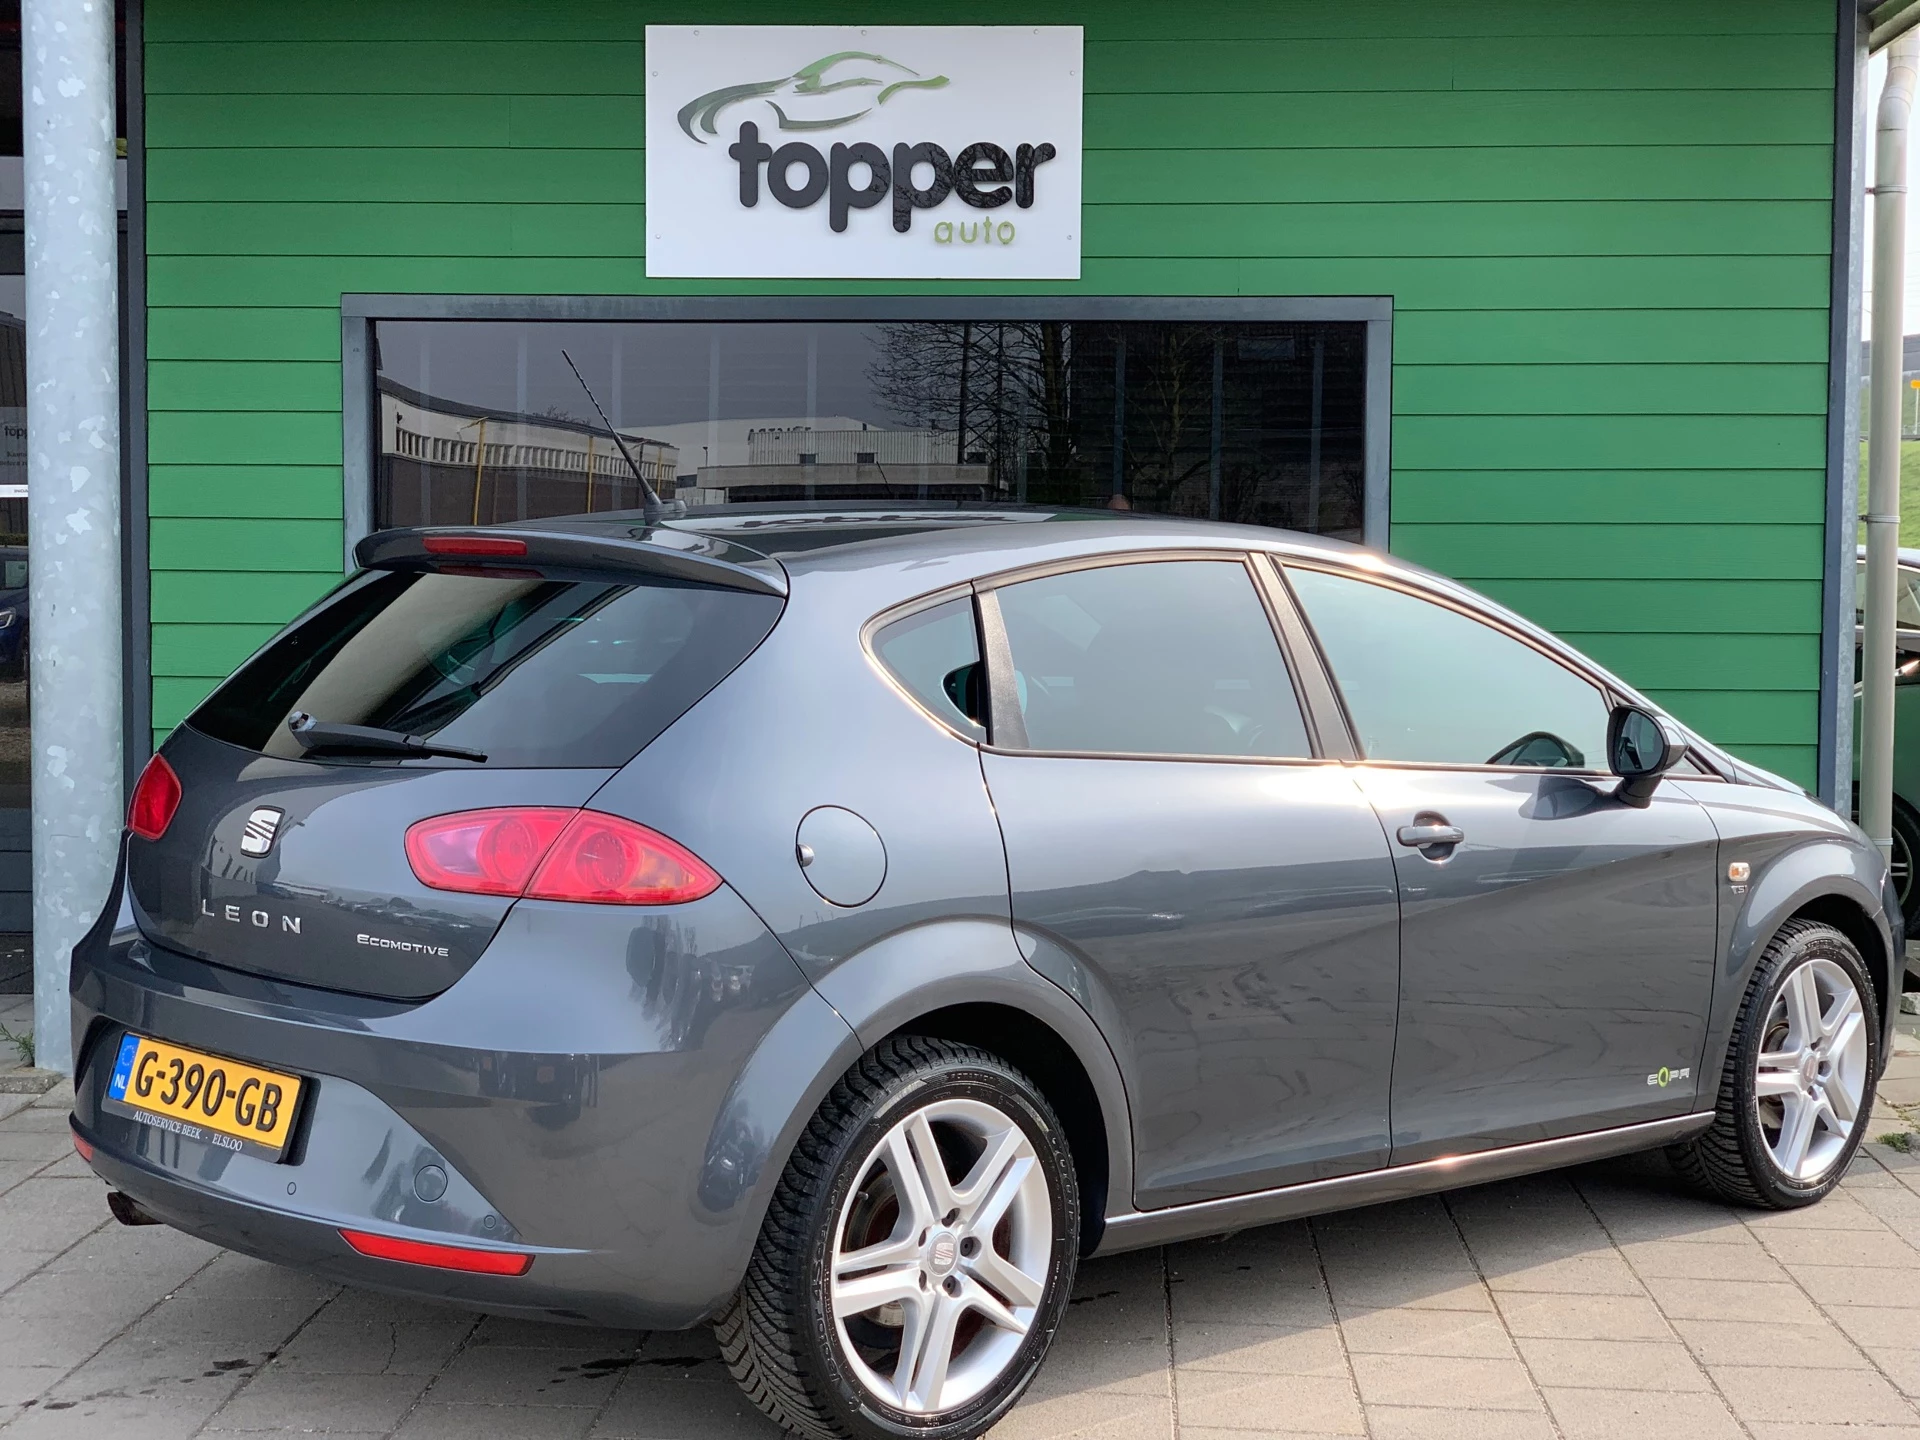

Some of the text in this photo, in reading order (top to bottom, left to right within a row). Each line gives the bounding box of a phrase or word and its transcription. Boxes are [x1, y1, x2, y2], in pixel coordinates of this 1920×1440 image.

[728, 120, 1057, 233] topper
[933, 215, 1016, 244] auto
[201, 898, 302, 934] LEON
[115, 1073, 126, 1089] NL
[135, 1051, 283, 1133] G-390-GB
[132, 1110, 243, 1151] AUTOSERVICE BEEK ELSLOO
